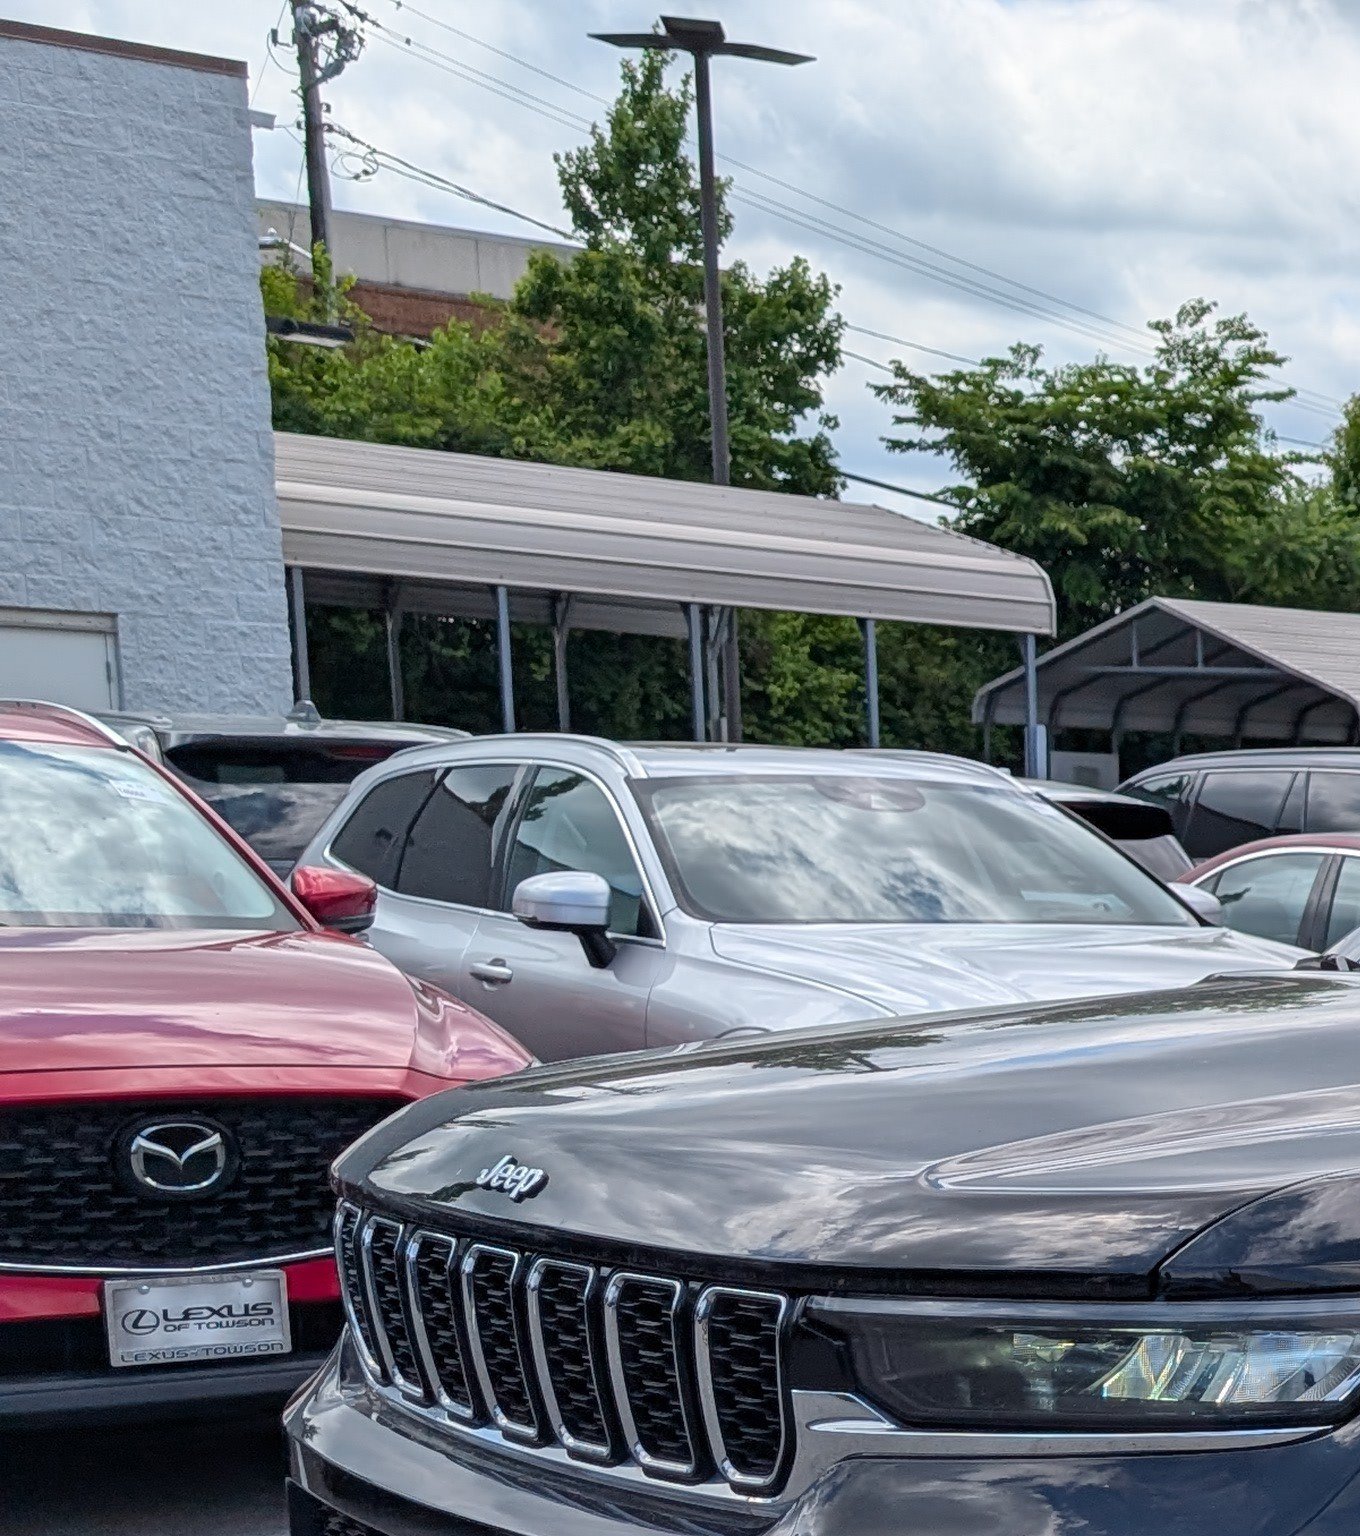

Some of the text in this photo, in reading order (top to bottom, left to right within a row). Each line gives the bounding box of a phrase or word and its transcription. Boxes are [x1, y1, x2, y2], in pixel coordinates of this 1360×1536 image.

[476, 1154, 545, 1199] Jeep
[162, 1302, 274, 1322] LEXUS
[163, 1318, 275, 1332] OF TOWSON
[120, 1351, 188, 1363] LEXUS
[201, 1342, 284, 1356] TOWSON
